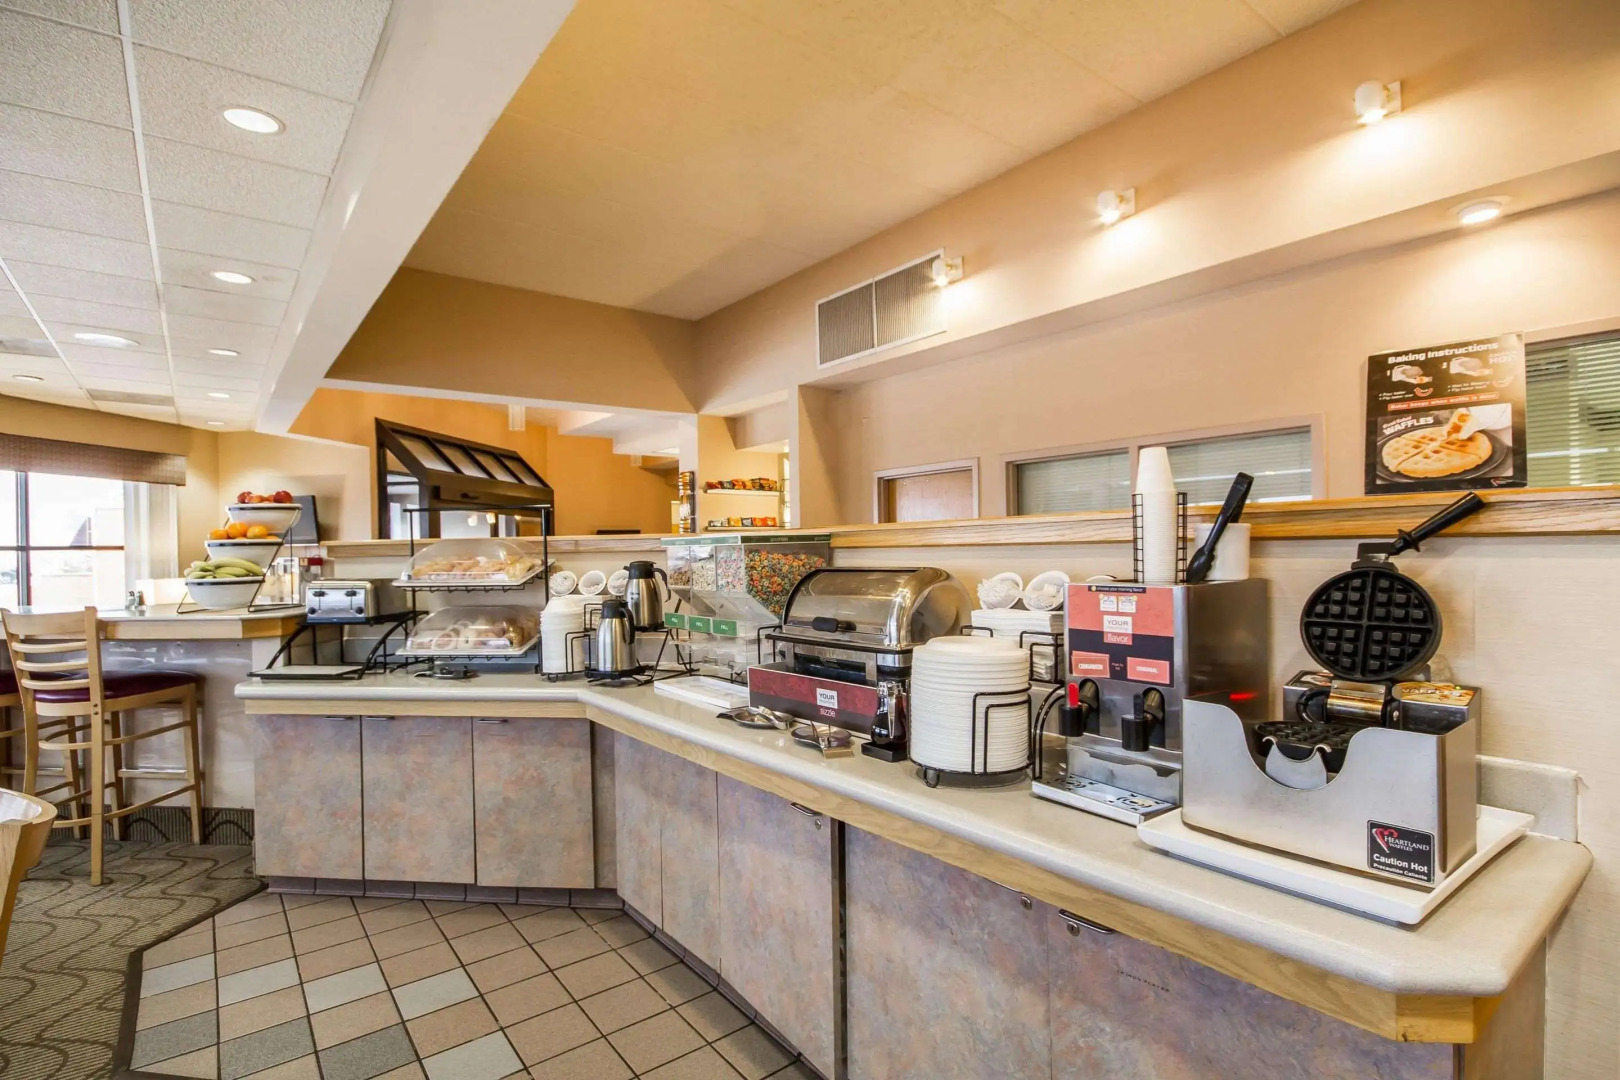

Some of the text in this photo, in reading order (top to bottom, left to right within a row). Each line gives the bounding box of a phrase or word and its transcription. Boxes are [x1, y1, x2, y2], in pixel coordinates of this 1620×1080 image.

[1387, 353, 1426, 364] Baking
[1427, 342, 1499, 358] Instructions
[1383, 417, 1434, 435] WAFFLES
[1107, 633, 1129, 643] flavor
[819, 692, 835, 701] YOUR
[820, 708, 835, 717] sizzle
[1384, 836, 1430, 851] HEARTLAND
[1389, 843, 1413, 852] WAFFLES
[1373, 853, 1428, 873] Caution Hot
